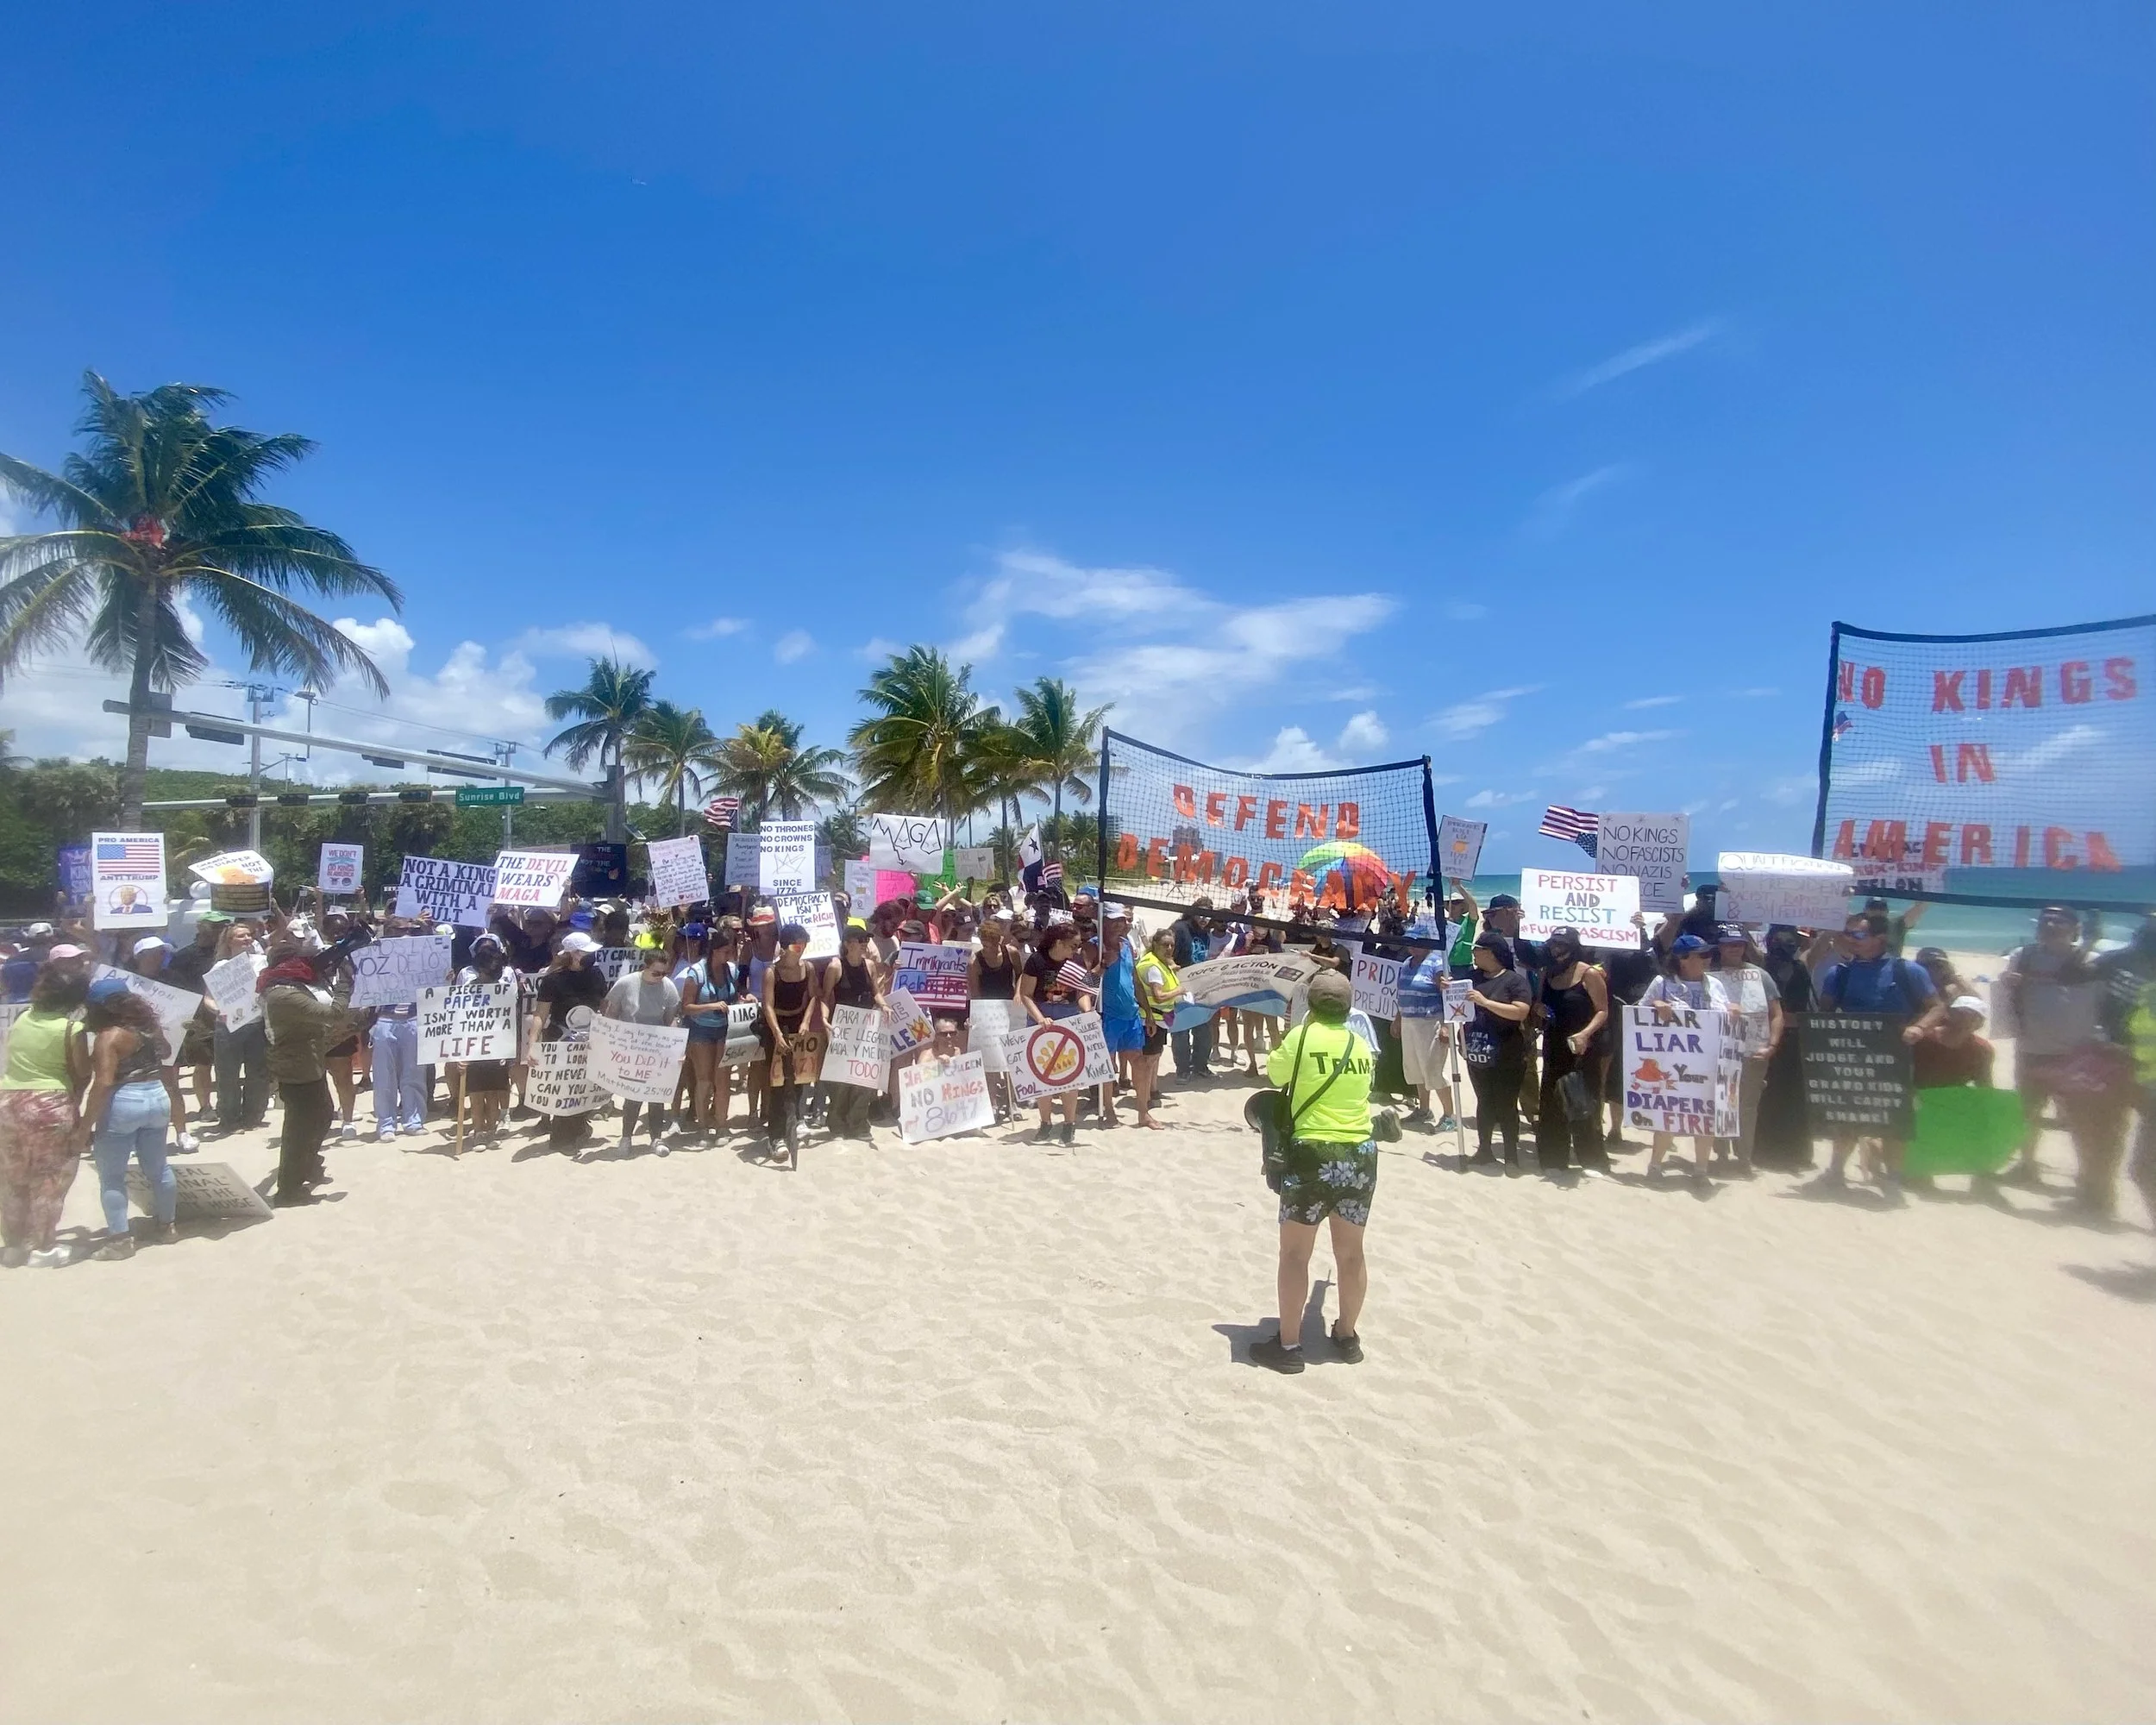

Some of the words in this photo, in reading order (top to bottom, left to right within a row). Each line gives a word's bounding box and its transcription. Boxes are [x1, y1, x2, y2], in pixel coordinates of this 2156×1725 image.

[1837, 661, 1885, 710] NO
[1932, 656, 2136, 713] KINGS
[1931, 743, 1996, 783] IN
[459, 793, 494, 801] Sunrise
[498, 792, 520, 800] Blvd
[1173, 784, 1359, 840] DEFEND
[775, 825, 814, 833] THRONES
[1603, 826, 1630, 843] NO
[1633, 826, 1678, 844] KINGS
[774, 844, 805, 853] KINGS
[873, 818, 942, 865] MAGA
[1832, 819, 2123, 873] AMERICA
[1601, 845, 1629, 862] NO
[1630, 846, 1684, 863] FASCISTS
[241, 860, 262, 869] NOT
[404, 859, 436, 877] NOT
[441, 863, 450, 878] A
[454, 865, 496, 883] KING
[498, 856, 526, 869] THE
[525, 857, 568, 874] DEVIL
[1601, 864, 1628, 876] NO
[1630, 865, 1673, 879] NAZIS
[401, 873, 412, 888] A
[415, 875, 496, 898] CRIMINAL
[499, 872, 555, 888] WEARS
[1539, 875, 1618, 893] PERSIST
[496, 887, 541, 902] MAGA
[777, 887, 798, 895] 1776
[415, 889, 461, 906] WITH
[467, 896, 478, 911] A
[777, 894, 829, 907] DEMOCRACY
[1564, 892, 1601, 907] AND
[421, 906, 463, 924] ULT
[797, 903, 822, 915] ISN'T
[1539, 905, 1616, 925] RESIST
[1727, 901, 1741, 920] &
[782, 914, 805, 925] LEFT
[897, 947, 967, 976] Immigrants
[1188, 967, 1218, 978] HOPE
[1232, 960, 1280, 970] ACTION
[425, 988, 434, 999] A
[448, 984, 484, 996] PIECE
[494, 983, 511, 994] OF
[1382, 986, 1399, 999] OV
[444, 994, 491, 1009] PAPER
[1354, 989, 1401, 1018] PREJUD
[423, 1009, 455, 1026] ISN'T
[465, 1007, 511, 1019] WORTH
[836, 1008, 859, 1025] PARA
[862, 1013, 876, 1025] MI
[1069, 1017, 1082, 1026] WE
[1633, 1007, 1702, 1030] LIAR
[425, 1023, 454, 1038] MORE
[460, 1019, 495, 1032] THAN
[502, 1018, 511, 1030] A
[1076, 1022, 1099, 1032] SURE
[1810, 1019, 1883, 1031] HISTORY
[833, 1026, 852, 1041] QUE
[1000, 1034, 1026, 1047] WE'VE
[1083, 1032, 1101, 1042] DON'T
[440, 1035, 494, 1058] LIFE
[541, 1043, 558, 1053] YOU
[567, 1043, 587, 1052] CAN
[1087, 1042, 1105, 1052] NEED
[1635, 1032, 1703, 1054] LIAR
[1829, 1038, 1866, 1049] WILL
[544, 1054, 557, 1064] TO
[567, 1054, 588, 1065] LOOK
[854, 1045, 861, 1057] Y
[862, 1046, 876, 1059] ME
[1006, 1051, 1024, 1065] GOT
[1805, 1052, 1859, 1063] JUDGE
[1865, 1054, 1895, 1064] AND
[530, 1069, 552, 1081] BUT
[617, 1066, 630, 1076] to
[1015, 1066, 1024, 1075] A
[1086, 1059, 1112, 1079] KING!
[1672, 1063, 1708, 1085] Your
[1833, 1066, 1876, 1077] YOUR
[537, 1083, 561, 1095] CAN
[569, 1083, 587, 1095] YOU
[597, 1070, 641, 1094] Matthew
[1808, 1079, 1864, 1092] GRAND
[530, 1093, 549, 1107] YOU
[911, 1088, 935, 1108] NO
[942, 1080, 984, 1102] KINGS
[1809, 1093, 1846, 1105] WILL
[1853, 1095, 1902, 1108] CARRY
[1626, 1091, 1715, 1115] DIAPERS
[1631, 1111, 1653, 1127] On
[1663, 1112, 1714, 1136] FIRE
[1826, 1110, 1889, 1124] SHAME!
